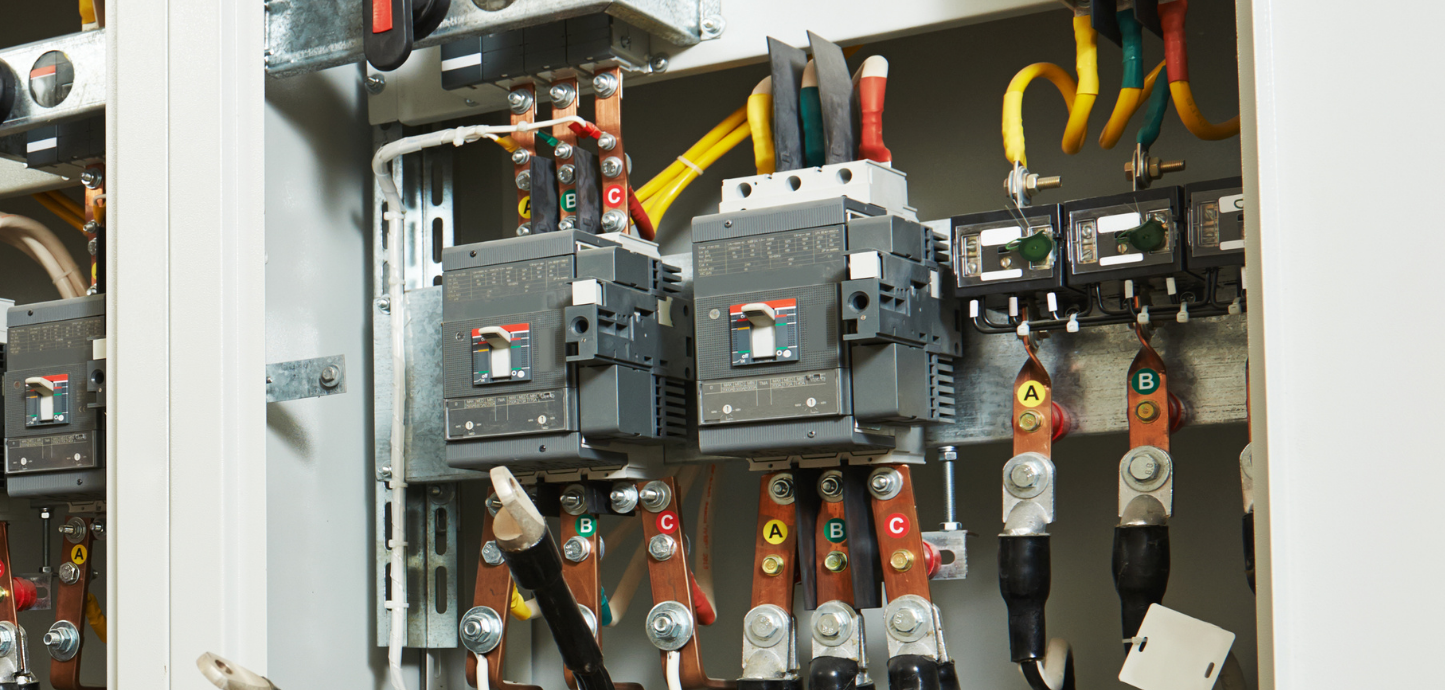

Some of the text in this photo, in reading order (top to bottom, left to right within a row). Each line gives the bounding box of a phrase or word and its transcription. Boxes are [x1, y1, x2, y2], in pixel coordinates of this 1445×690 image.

[566, 193, 576, 208] B
[608, 188, 621, 204] C
[1140, 372, 1154, 390] B
[1023, 385, 1039, 401] A
[580, 518, 593, 533] B
[662, 515, 674, 530] C
[890, 518, 903, 534] C
[769, 523, 783, 539] A
[830, 523, 843, 538] B
[74, 548, 84, 560] A
